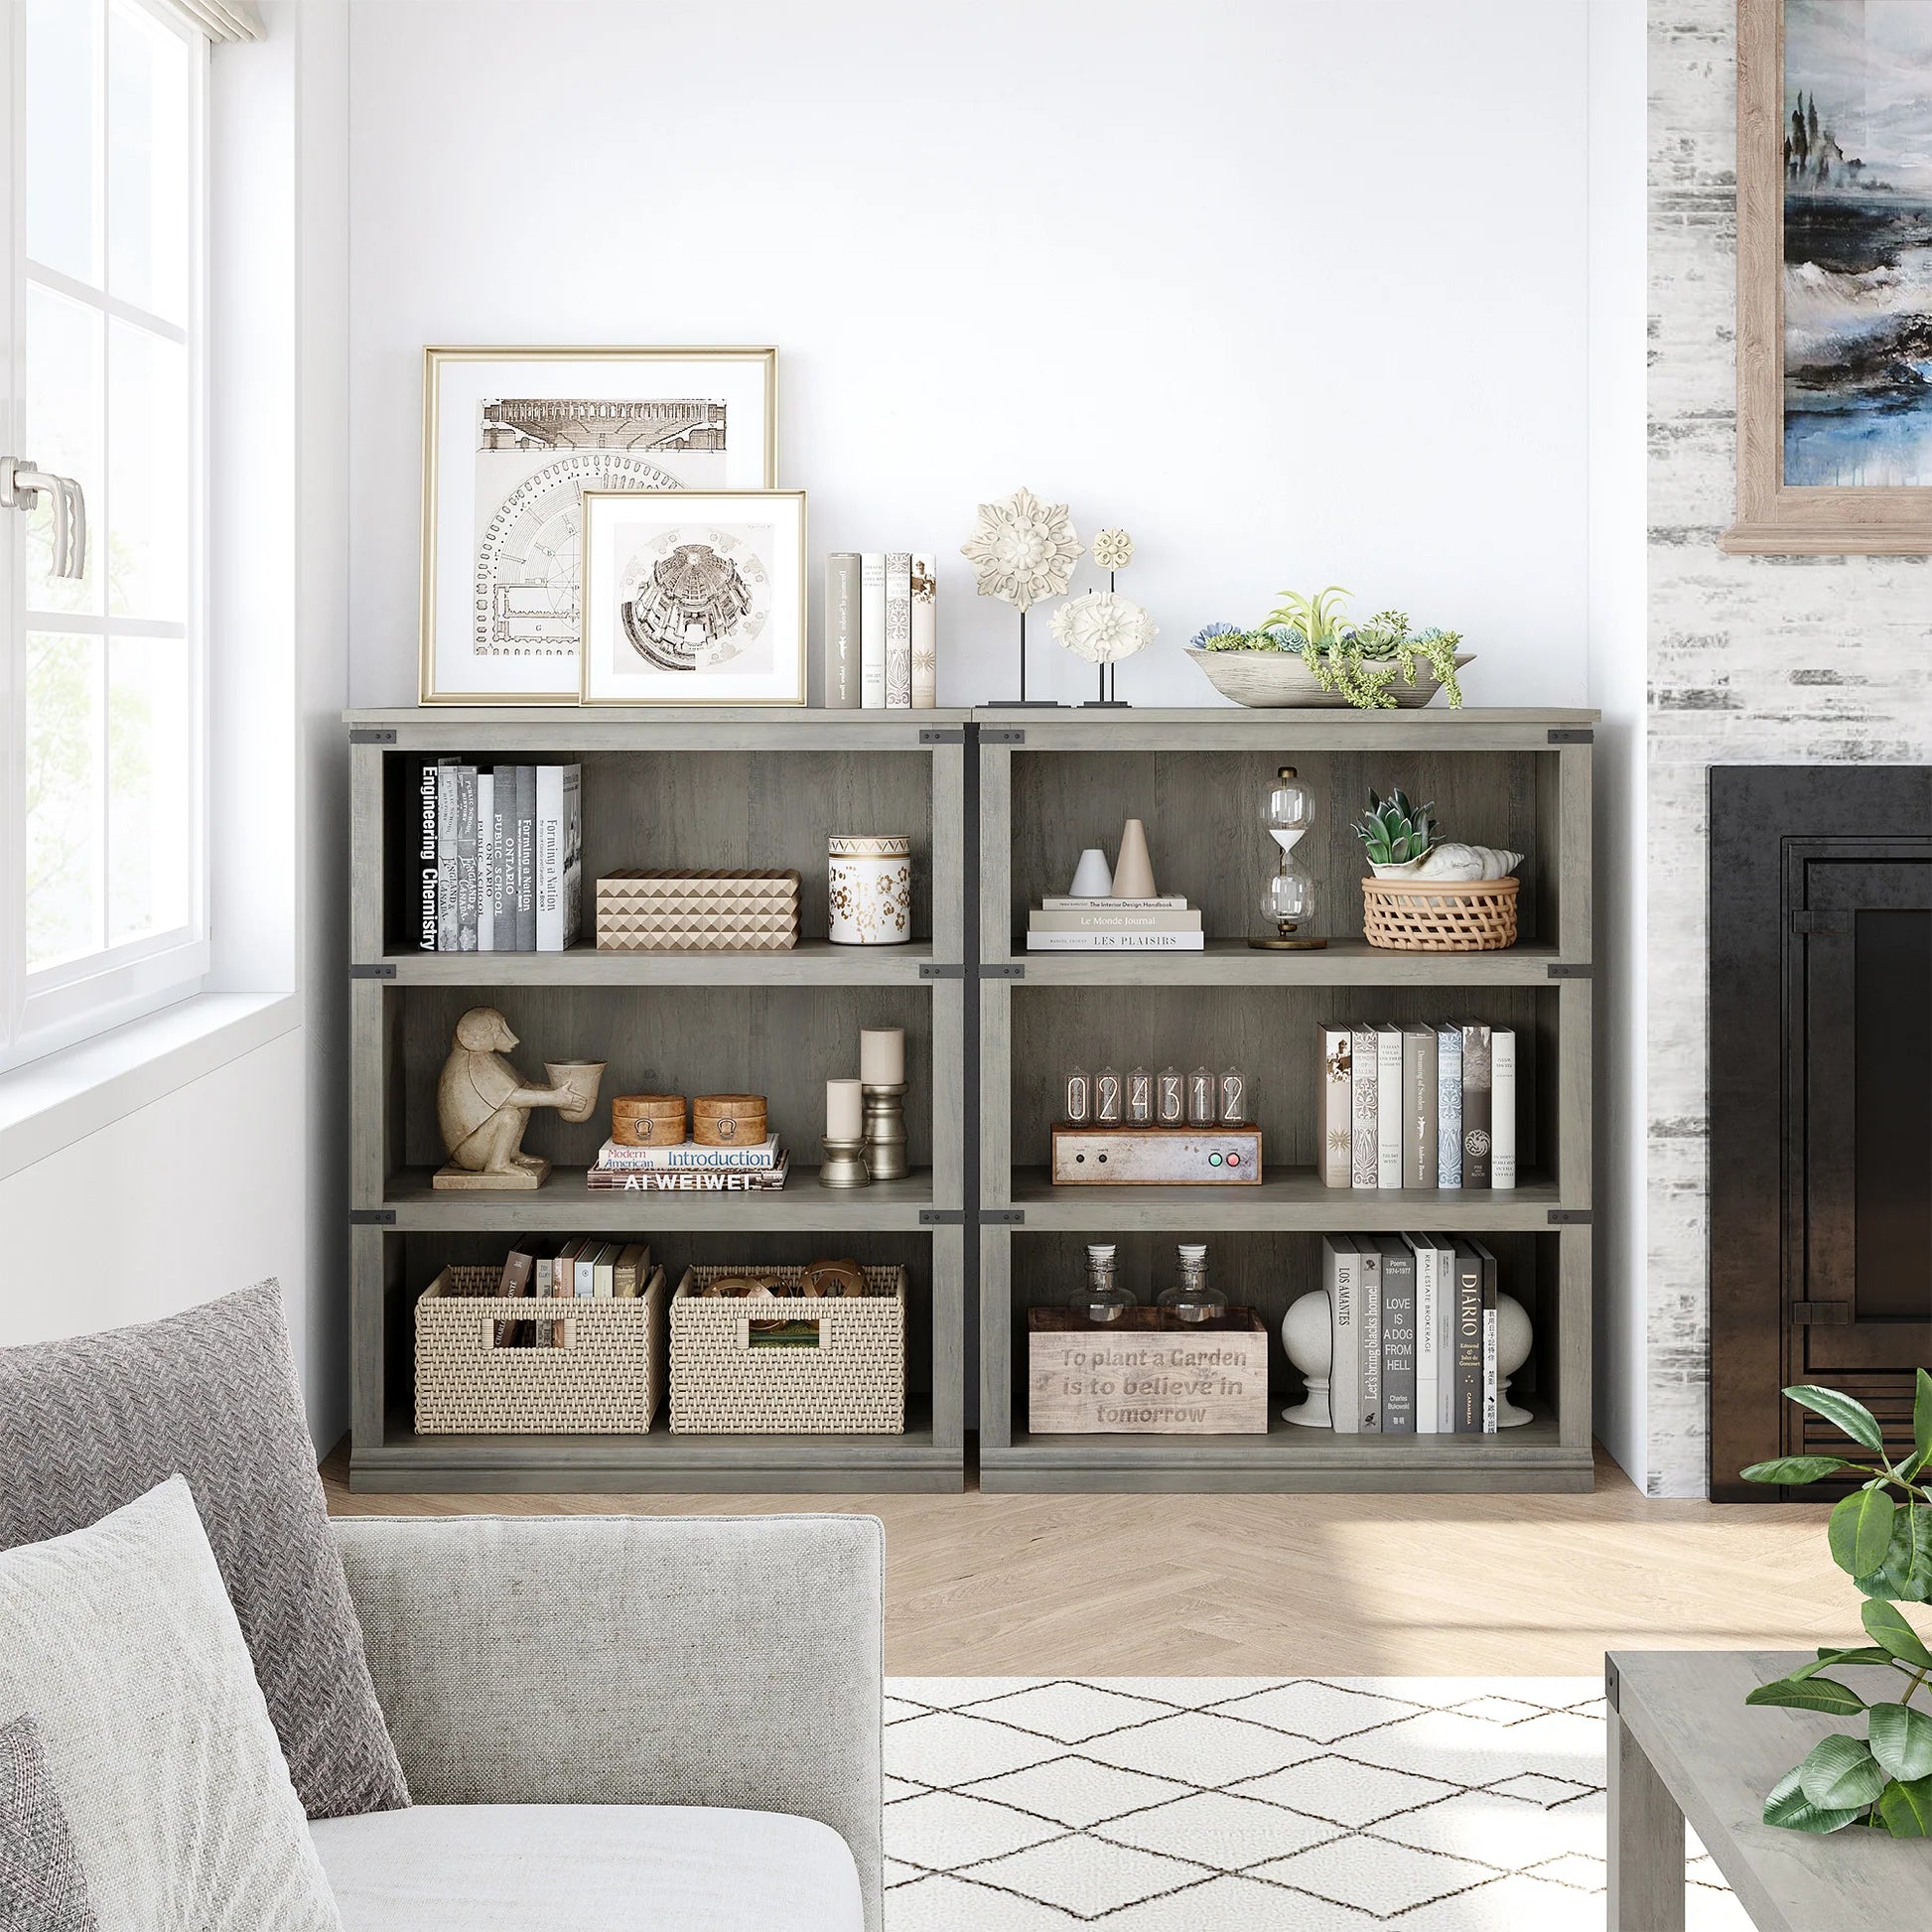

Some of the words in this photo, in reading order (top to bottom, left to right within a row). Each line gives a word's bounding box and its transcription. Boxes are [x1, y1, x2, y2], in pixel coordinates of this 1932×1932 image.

[465, 780, 474, 805] PUBLIC
[421, 766, 438, 860] Engineering
[465, 807, 475, 834] SCHOOL
[522, 819, 532, 865] Forming
[546, 820, 558, 865] Forming
[505, 838, 514, 895] ONTARIO
[458, 855, 477, 903] ENGLAND
[523, 876, 532, 911] Nation
[547, 877, 558, 911] Nation
[420, 868, 438, 951] Chemistry
[1093, 916, 1122, 925] Monde
[1123, 916, 1156, 926] Journal
[605, 1158, 654, 1168] American
[608, 1149, 646, 1159] Modern
[667, 1151, 771, 1167] Introduction
[655, 1173, 751, 1190] WEIWEI
[1338, 1267, 1350, 1284] LOS
[1338, 1285, 1350, 1326] AMANTES
[1364, 1286, 1377, 1316] home!
[1386, 1299, 1411, 1310] LOVE
[1461, 1274, 1481, 1336] DIÁRIO
[1394, 1313, 1403, 1324] IS
[1364, 1317, 1377, 1348] blacks
[1383, 1329, 1391, 1339] A
[1392, 1328, 1413, 1339] DOG
[1062, 1349, 1086, 1366] To
[1092, 1348, 1146, 1371] plant
[1153, 1352, 1165, 1366] a
[1170, 1348, 1247, 1366] Garden
[1385, 1344, 1412, 1355] FROM
[1364, 1348, 1381, 1376] bring
[1387, 1360, 1411, 1370] HELL
[1063, 1377, 1082, 1395] is
[1090, 1378, 1115, 1395] to
[1123, 1377, 1212, 1395] believe
[1220, 1377, 1242, 1395] in
[1364, 1377, 1377, 1400] Let's
[1097, 1406, 1206, 1423] tomorrow
